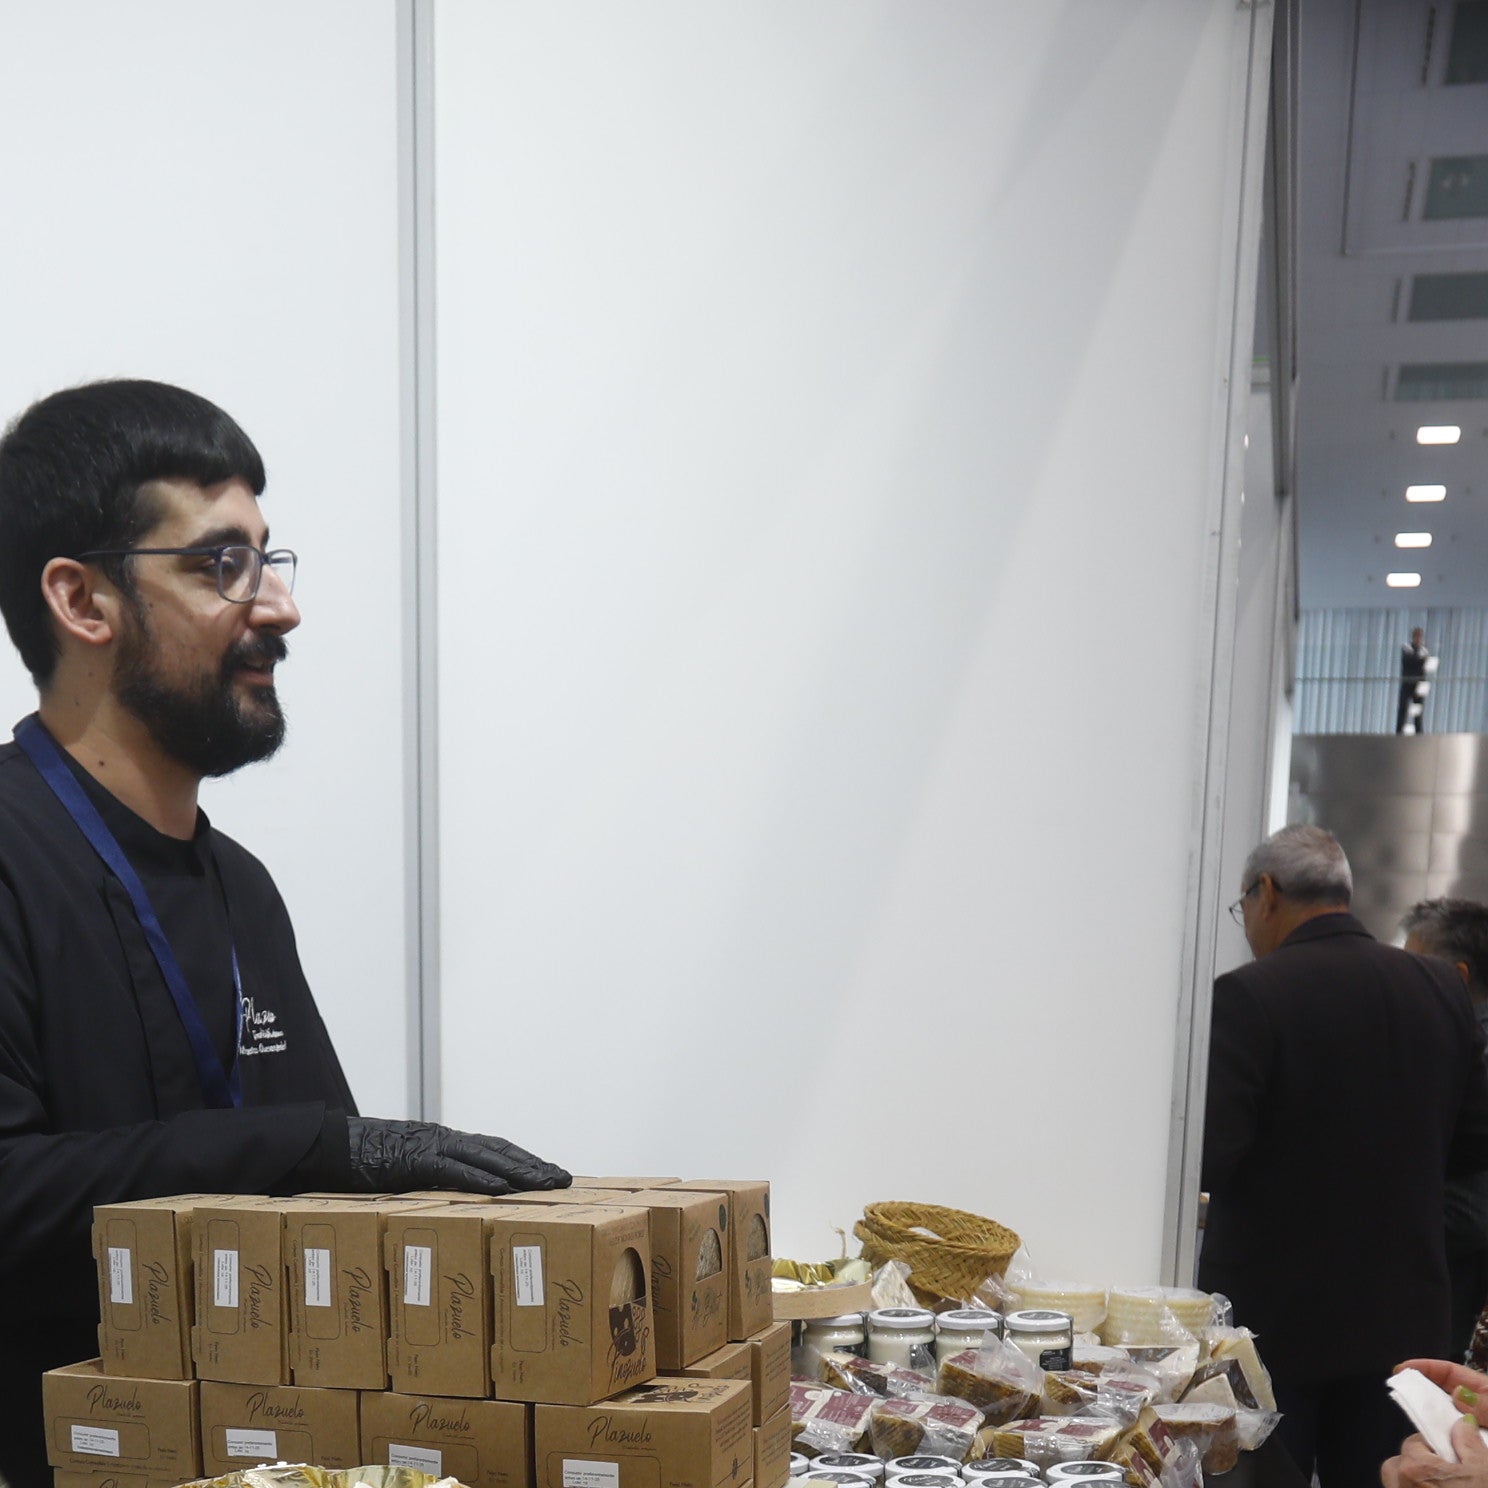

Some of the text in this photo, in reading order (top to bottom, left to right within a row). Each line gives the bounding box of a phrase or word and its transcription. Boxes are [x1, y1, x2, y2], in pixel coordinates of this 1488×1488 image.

[246, 1391, 305, 1423] Plazuelo
[409, 1403, 472, 1435] Plazuelo
[587, 1415, 652, 1448] Plazuelo
